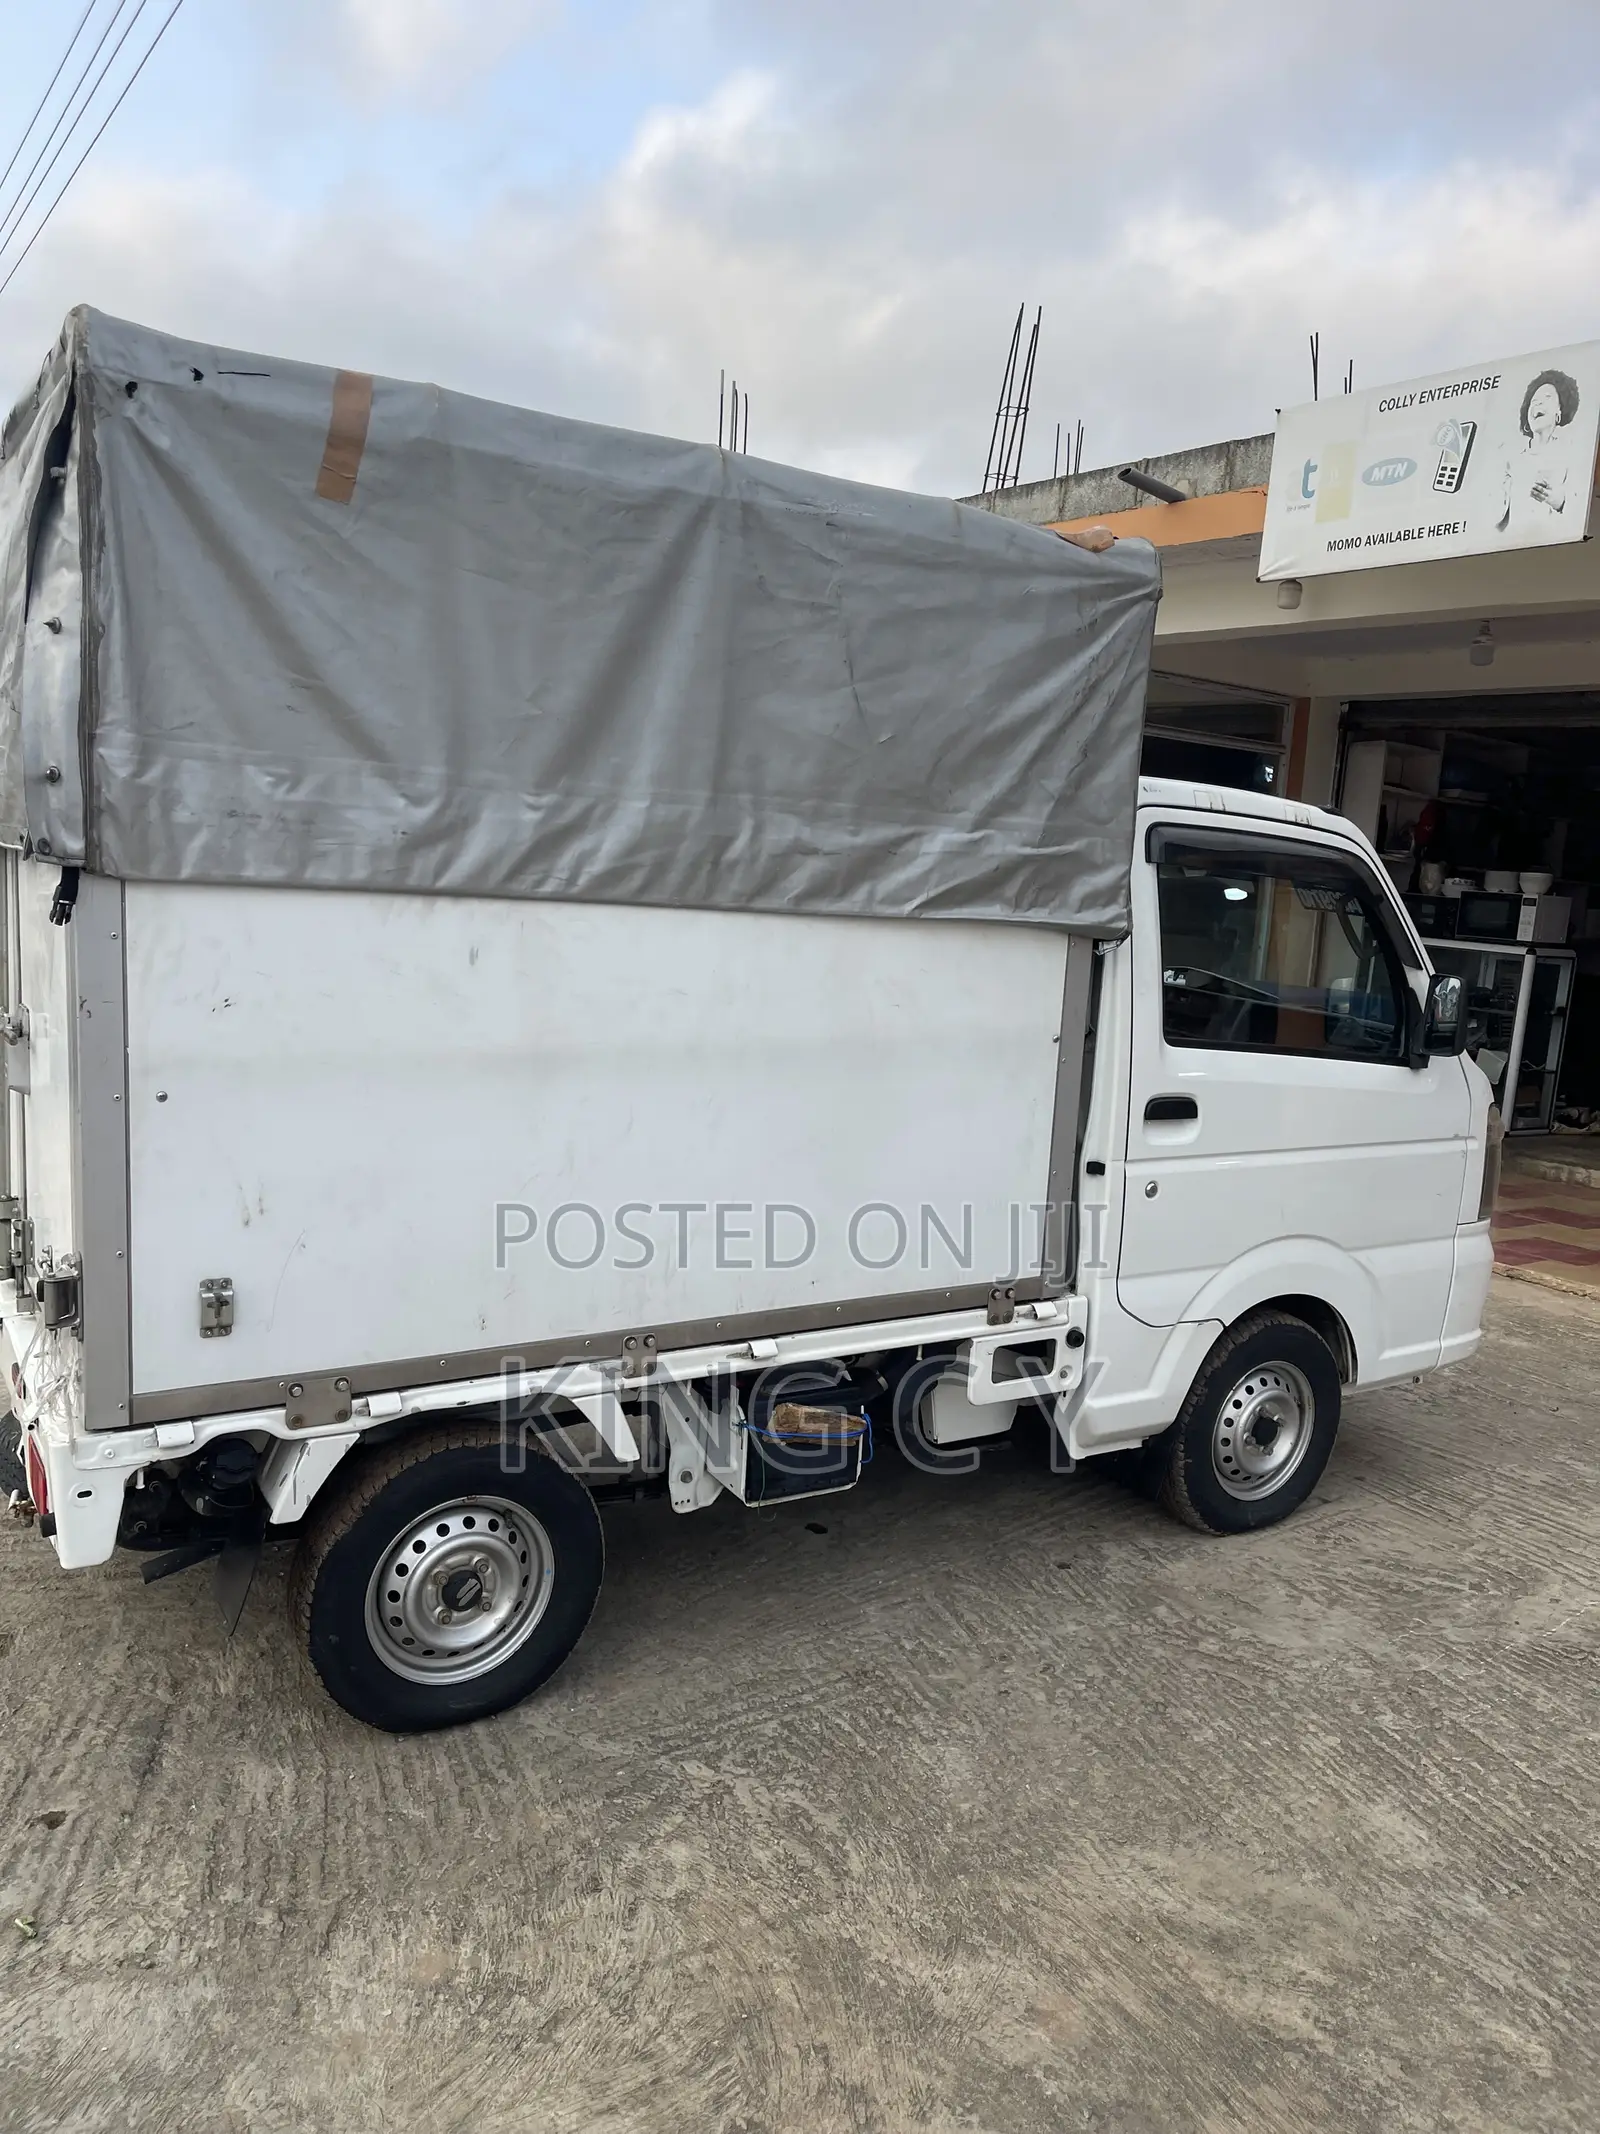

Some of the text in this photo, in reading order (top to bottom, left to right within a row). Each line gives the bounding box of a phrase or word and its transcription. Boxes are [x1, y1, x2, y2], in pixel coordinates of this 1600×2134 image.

[1379, 375, 1502, 413] COLLY ENTERPRISE
[1371, 461, 1408, 482] MTN
[1326, 536, 1362, 552] MOMO
[1364, 527, 1425, 547] AVAILABLE
[1427, 521, 1460, 538] HERE
